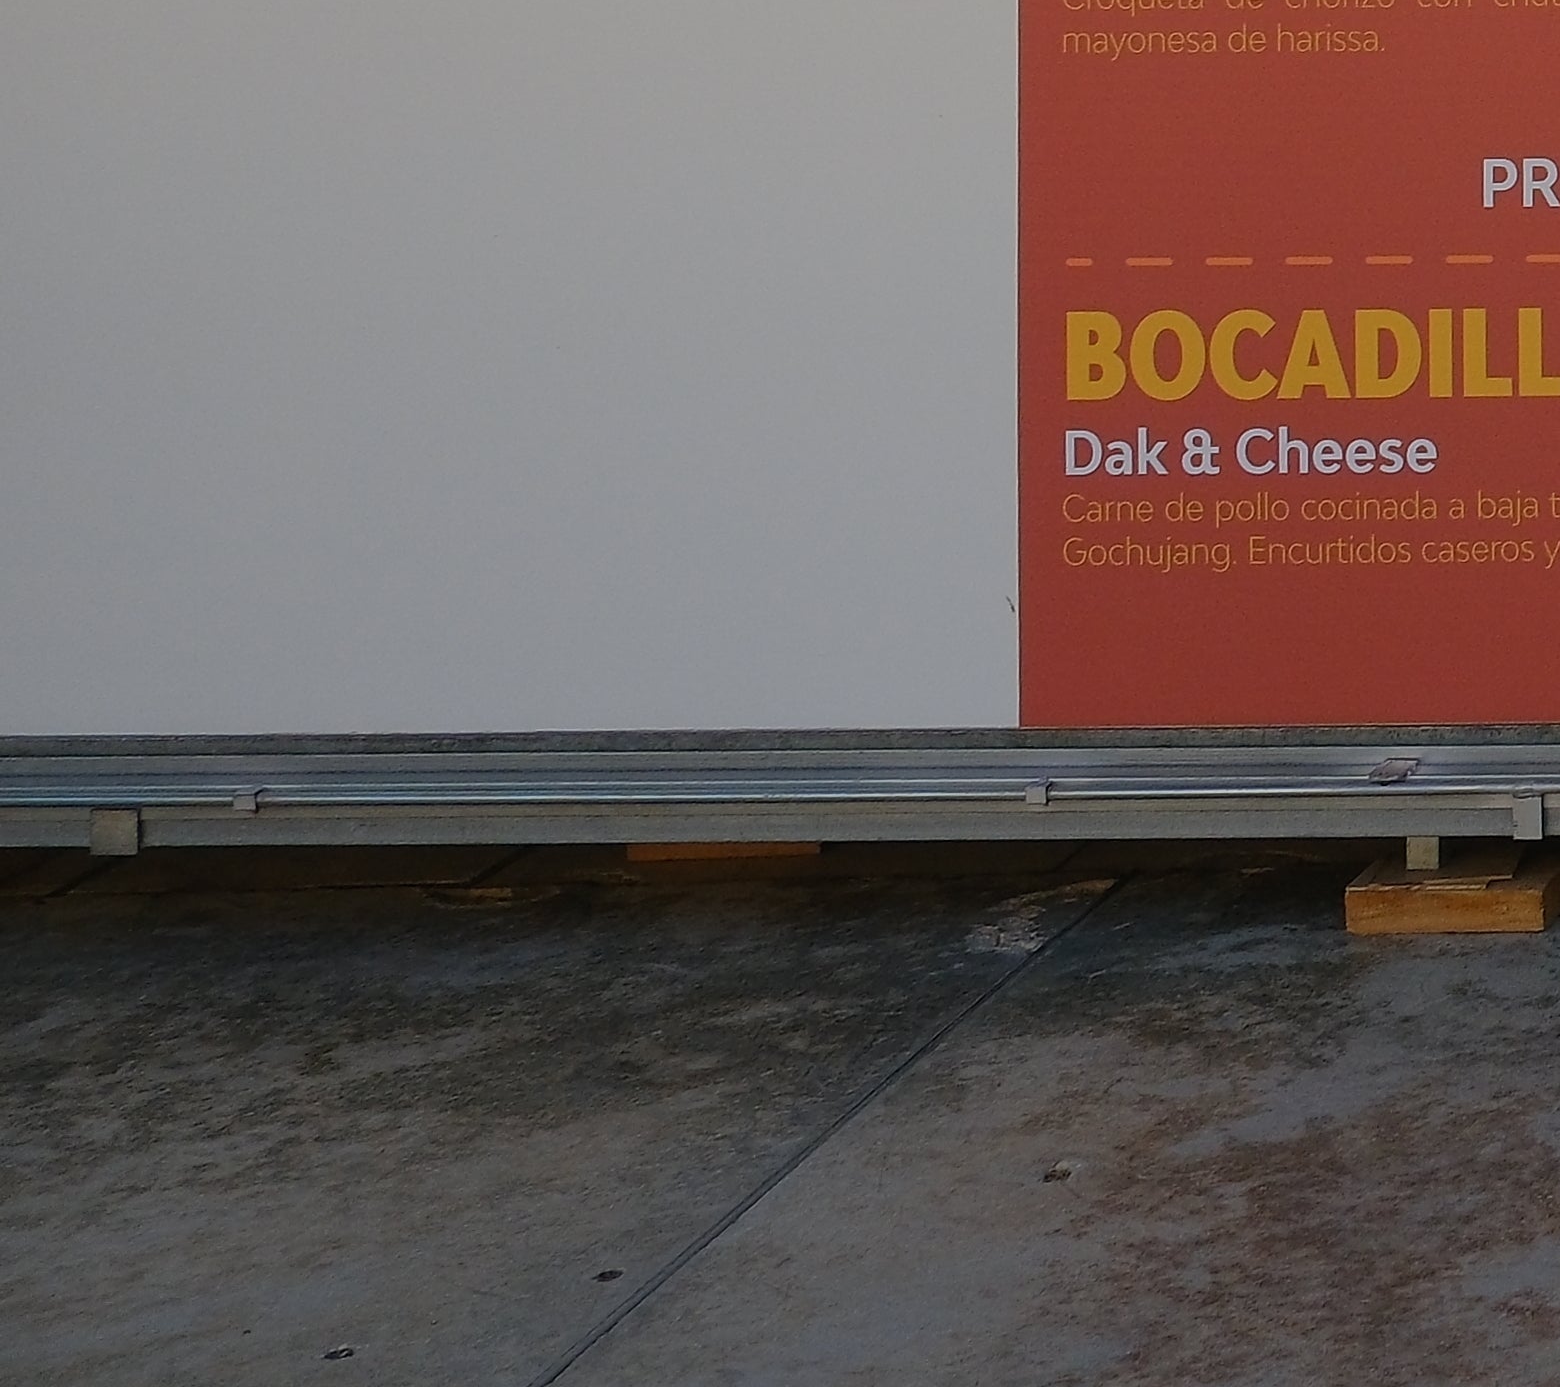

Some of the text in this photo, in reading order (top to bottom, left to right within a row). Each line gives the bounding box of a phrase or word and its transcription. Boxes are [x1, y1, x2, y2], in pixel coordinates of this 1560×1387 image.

[1062, 22, 1386, 62] mayonesa de harissa.
[1064, 425, 1439, 477] Dak & Cheese
[1061, 491, 1154, 524] Carne
[1164, 491, 1205, 523] de
[1215, 491, 1290, 529] pollo
[1300, 489, 1438, 522] cocinada
[1448, 498, 1466, 520] a
[1477, 489, 1540, 527] baja
[1062, 535, 1237, 574] Gochujang.
[1248, 533, 1412, 566] Encurtidos
[1421, 539, 1536, 564] caseros
